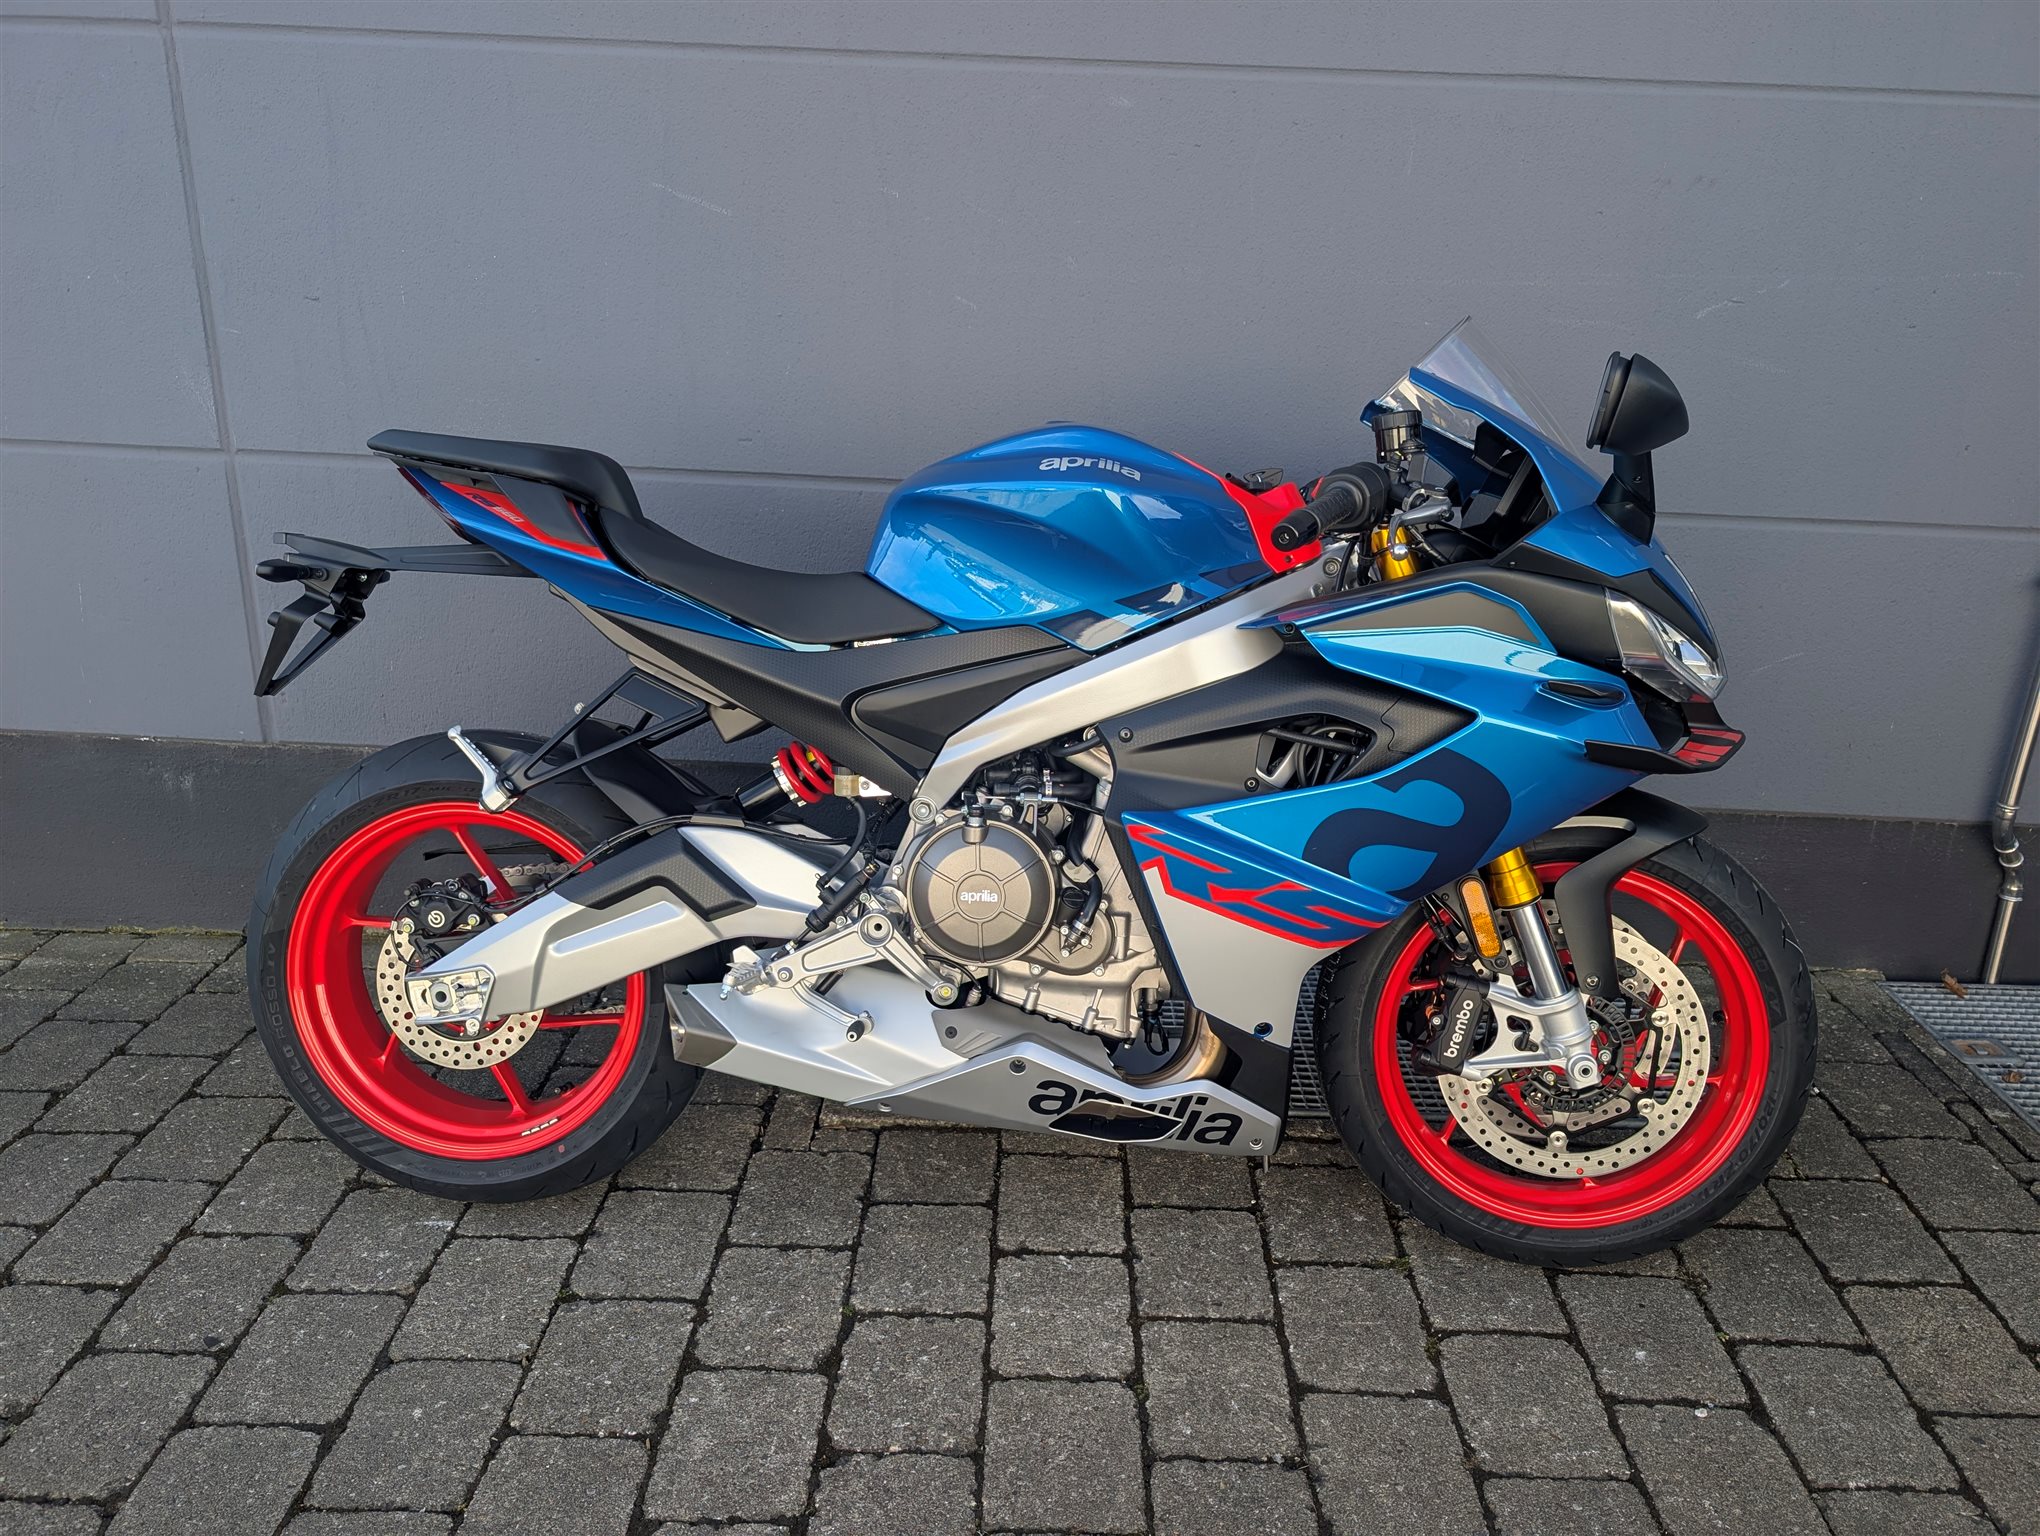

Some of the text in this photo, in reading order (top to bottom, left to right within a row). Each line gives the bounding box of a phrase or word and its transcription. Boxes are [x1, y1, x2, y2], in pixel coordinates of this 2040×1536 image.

[1039, 457, 1141, 482] aprilia
[960, 889, 998, 904] aprilia
[266, 975, 289, 1039] ROSSO
[1443, 1000, 1474, 1058] brembo
